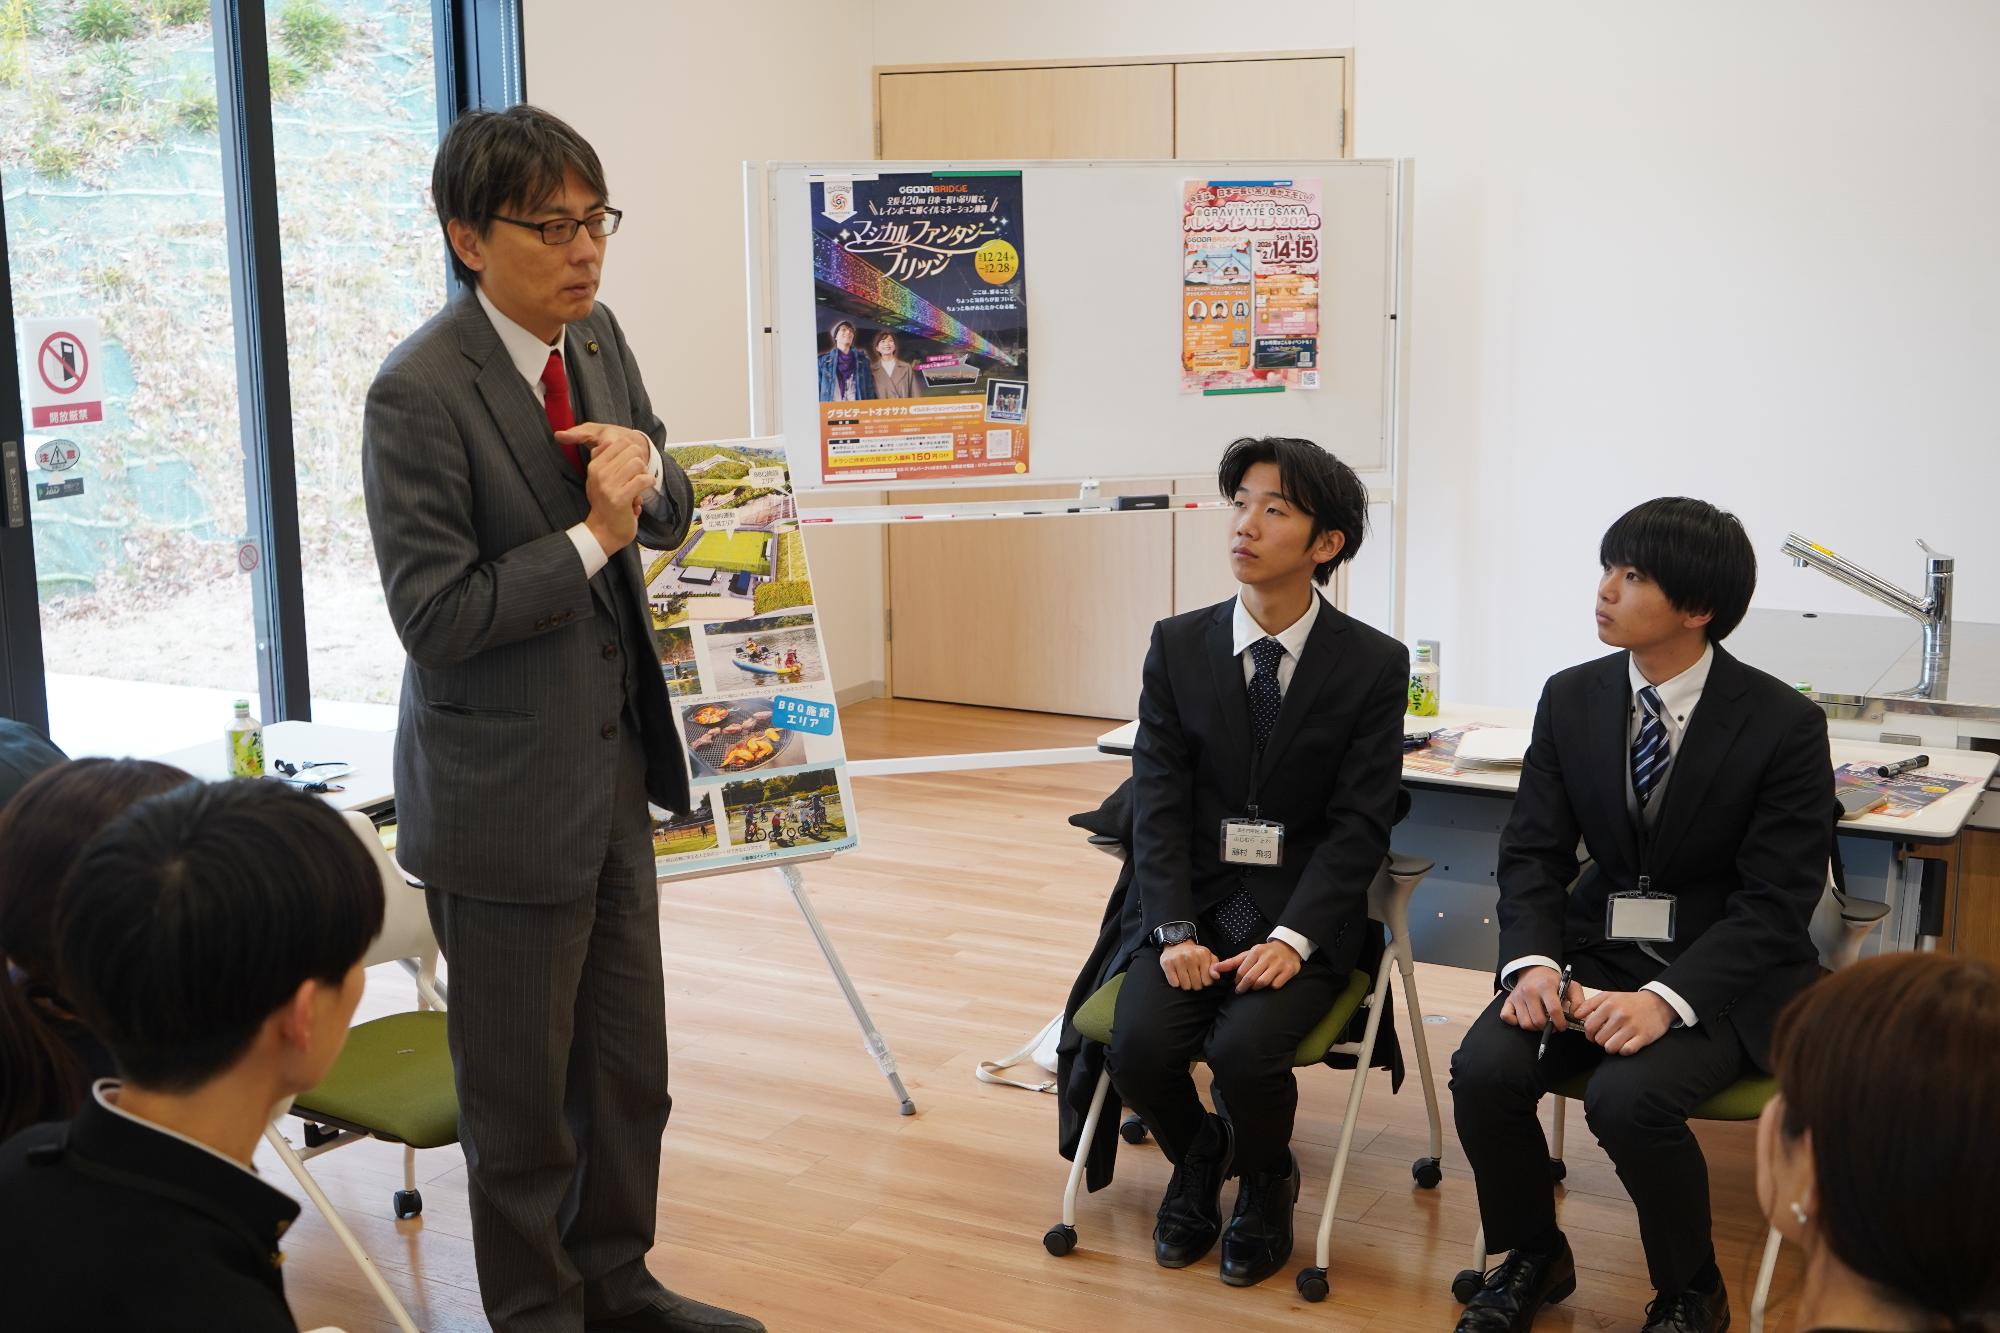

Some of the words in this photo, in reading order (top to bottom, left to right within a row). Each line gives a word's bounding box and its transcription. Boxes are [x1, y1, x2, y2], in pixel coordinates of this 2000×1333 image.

[886, 196, 926, 206] 全長420m
[1268, 208, 1306, 216] OSAKA
[853, 220, 996, 246] マジカルファンタジー
[881, 247, 953, 282] ブリッジ
[50, 409, 88, 424] 開放厳禁
[828, 406, 908, 418] グラビテートオオサカ
[40, 453, 49, 463] 注
[912, 452, 930, 460] 150
[778, 700, 830, 718] BBQ施設
[787, 714, 819, 728] エリア
